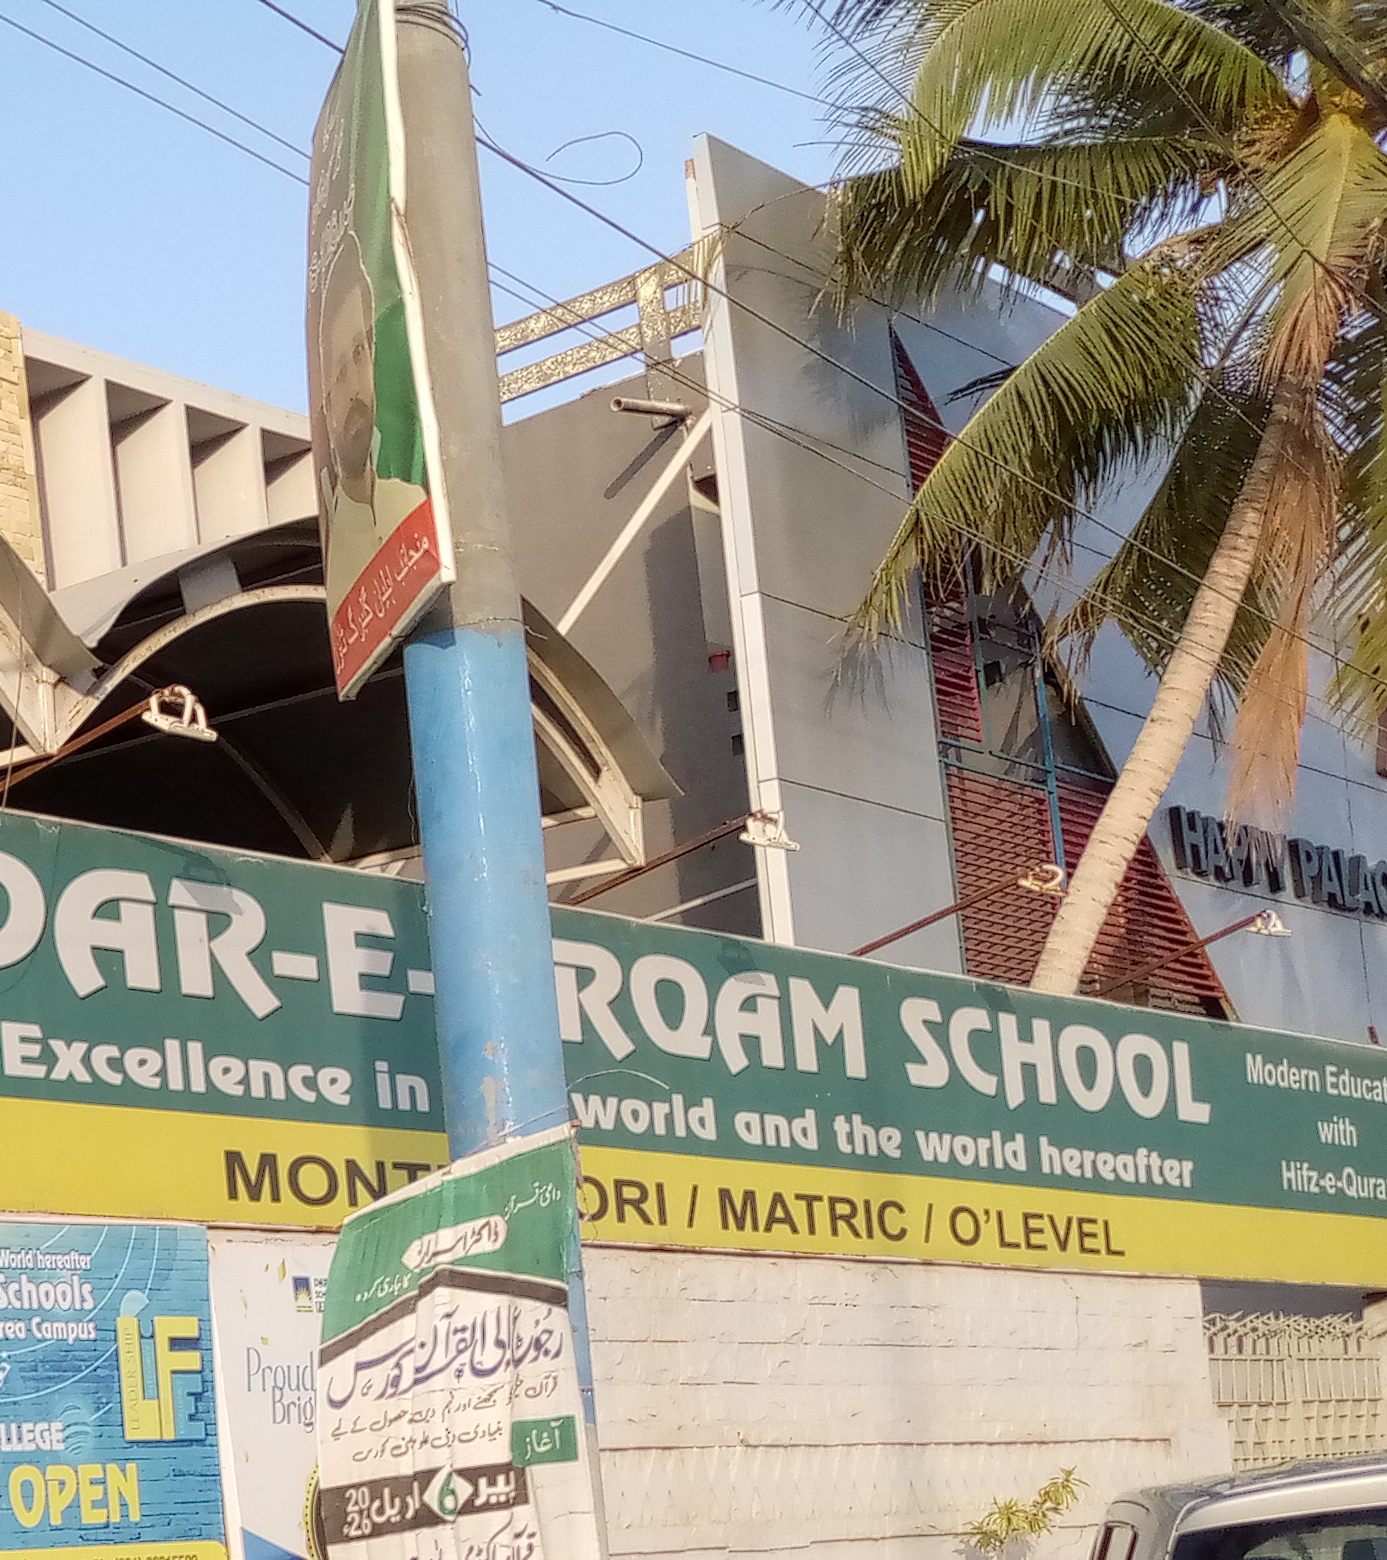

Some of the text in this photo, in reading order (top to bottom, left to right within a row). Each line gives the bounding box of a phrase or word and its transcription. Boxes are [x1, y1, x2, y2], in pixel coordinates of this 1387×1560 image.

[899, 996, 1213, 1126] SCHOOL
[1245, 1052, 1321, 1092] Modern
[0, 1020, 1195, 1190] Excellence in world and the world hereafter
[1317, 1115, 1358, 1148] with
[224, 1149, 669, 1228] MONTORI
[717, 1186, 908, 1243] MATRIC
[36, 1248, 92, 1271] hereafter
[30, 1317, 97, 1345] Campus
[246, 1346, 315, 1393] Proud
[525, 1418, 564, 1461] آغاز
[9, 1462, 142, 1528] OPEN
[345, 1486, 370, 1513] 20
[438, 1470, 458, 1515] 6
